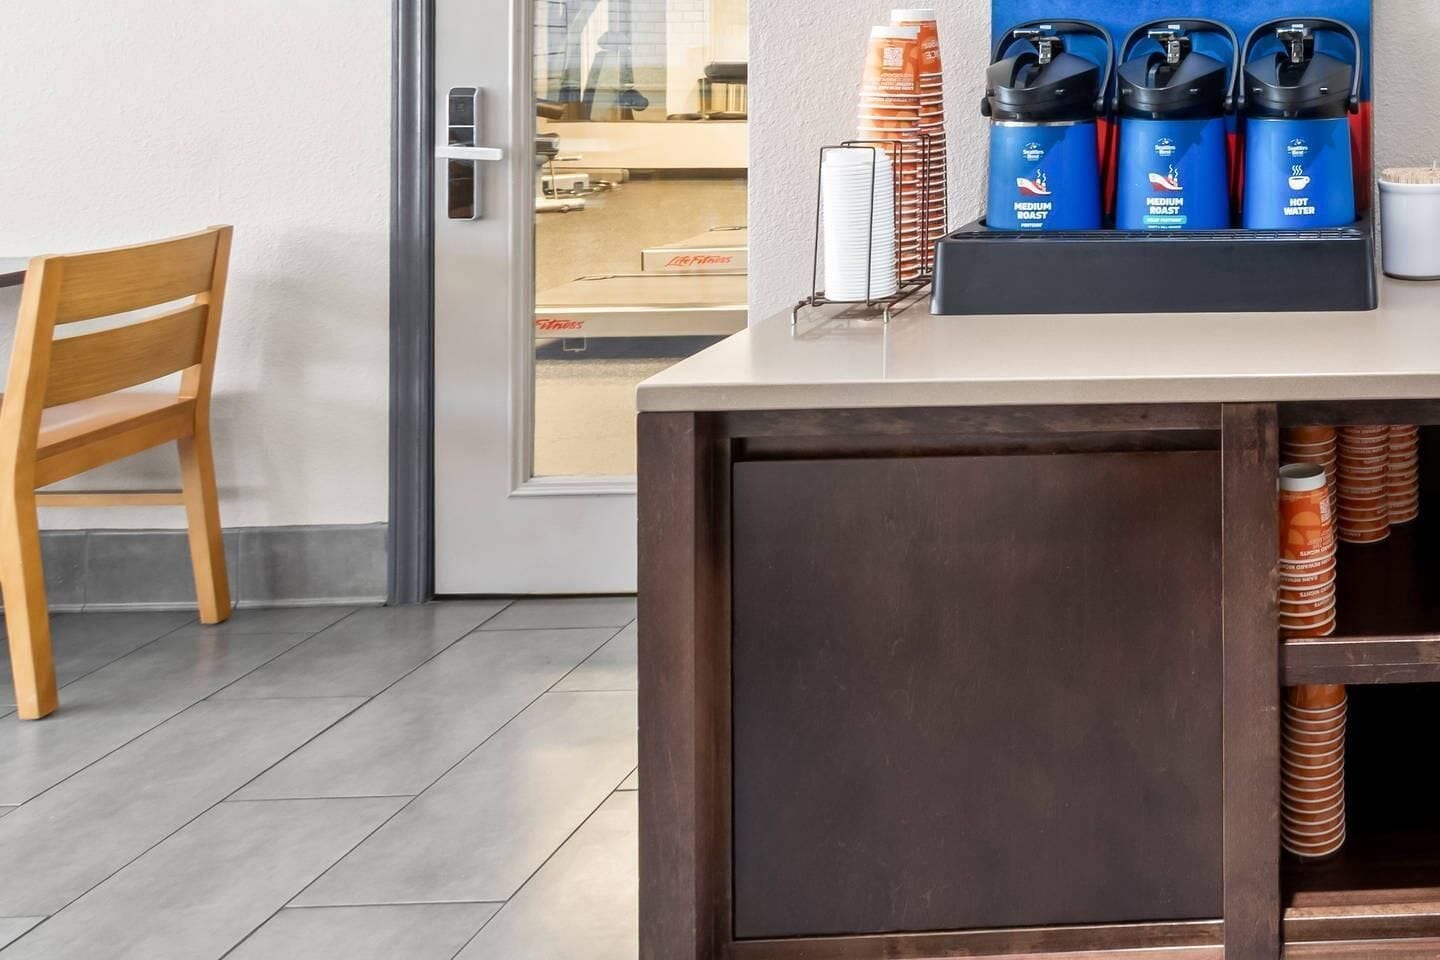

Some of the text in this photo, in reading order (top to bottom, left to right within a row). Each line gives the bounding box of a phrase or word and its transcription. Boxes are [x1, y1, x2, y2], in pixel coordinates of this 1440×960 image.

[1014, 202, 1052, 211] MEDIUM
[1146, 198, 1184, 206] MEDIUM
[1289, 197, 1309, 207] HOT
[1149, 206, 1181, 215] ROAST
[1283, 206, 1316, 216] WATER
[1017, 211, 1049, 220] ROAST
